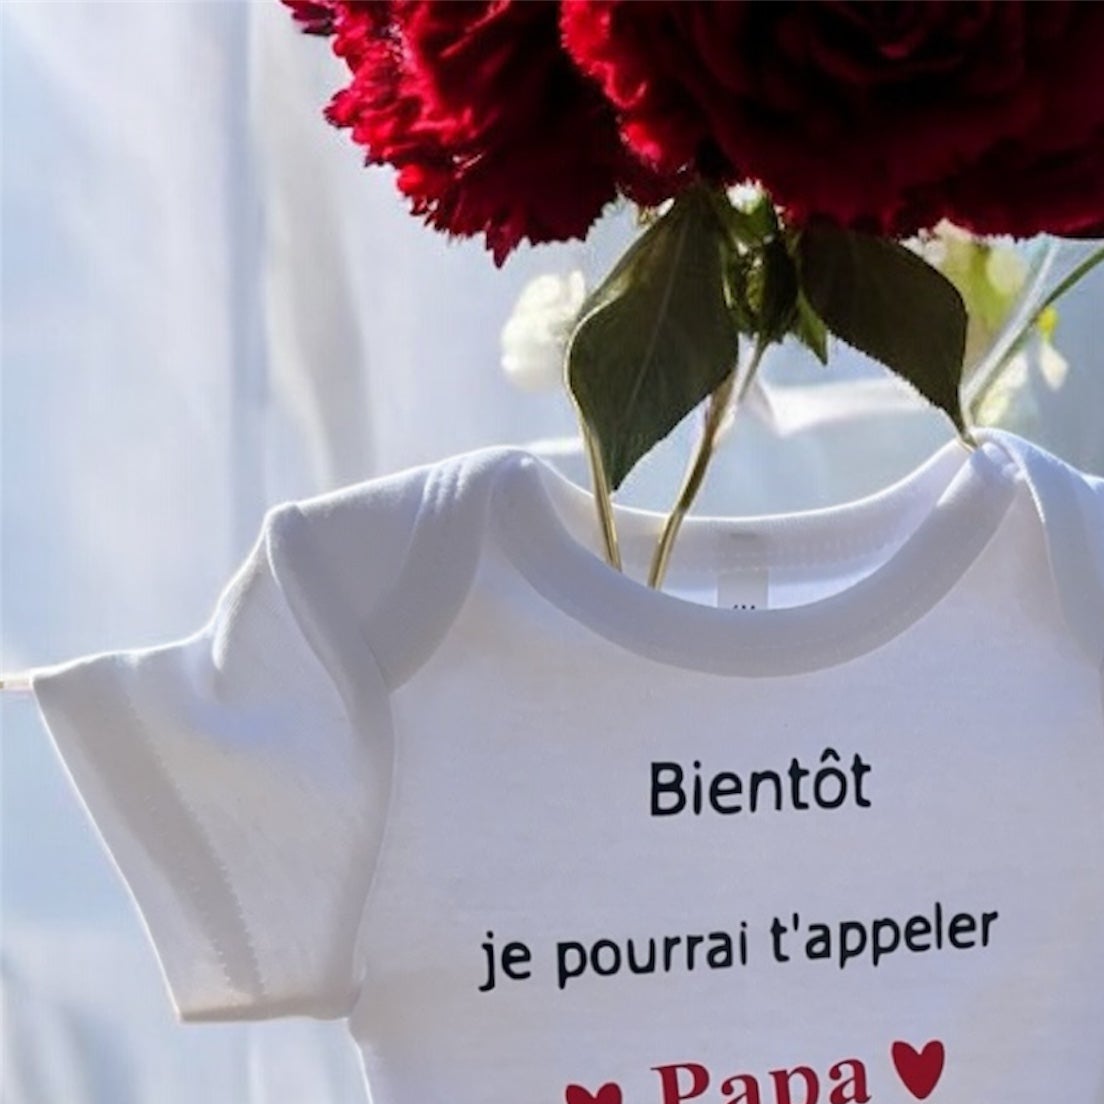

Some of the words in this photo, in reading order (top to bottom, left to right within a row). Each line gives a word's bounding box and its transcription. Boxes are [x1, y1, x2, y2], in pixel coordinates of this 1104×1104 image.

[650, 745, 873, 817] Bientôt
[477, 930, 532, 993] je
[556, 920, 748, 991] pourrai
[769, 901, 1000, 970] t'appeler
